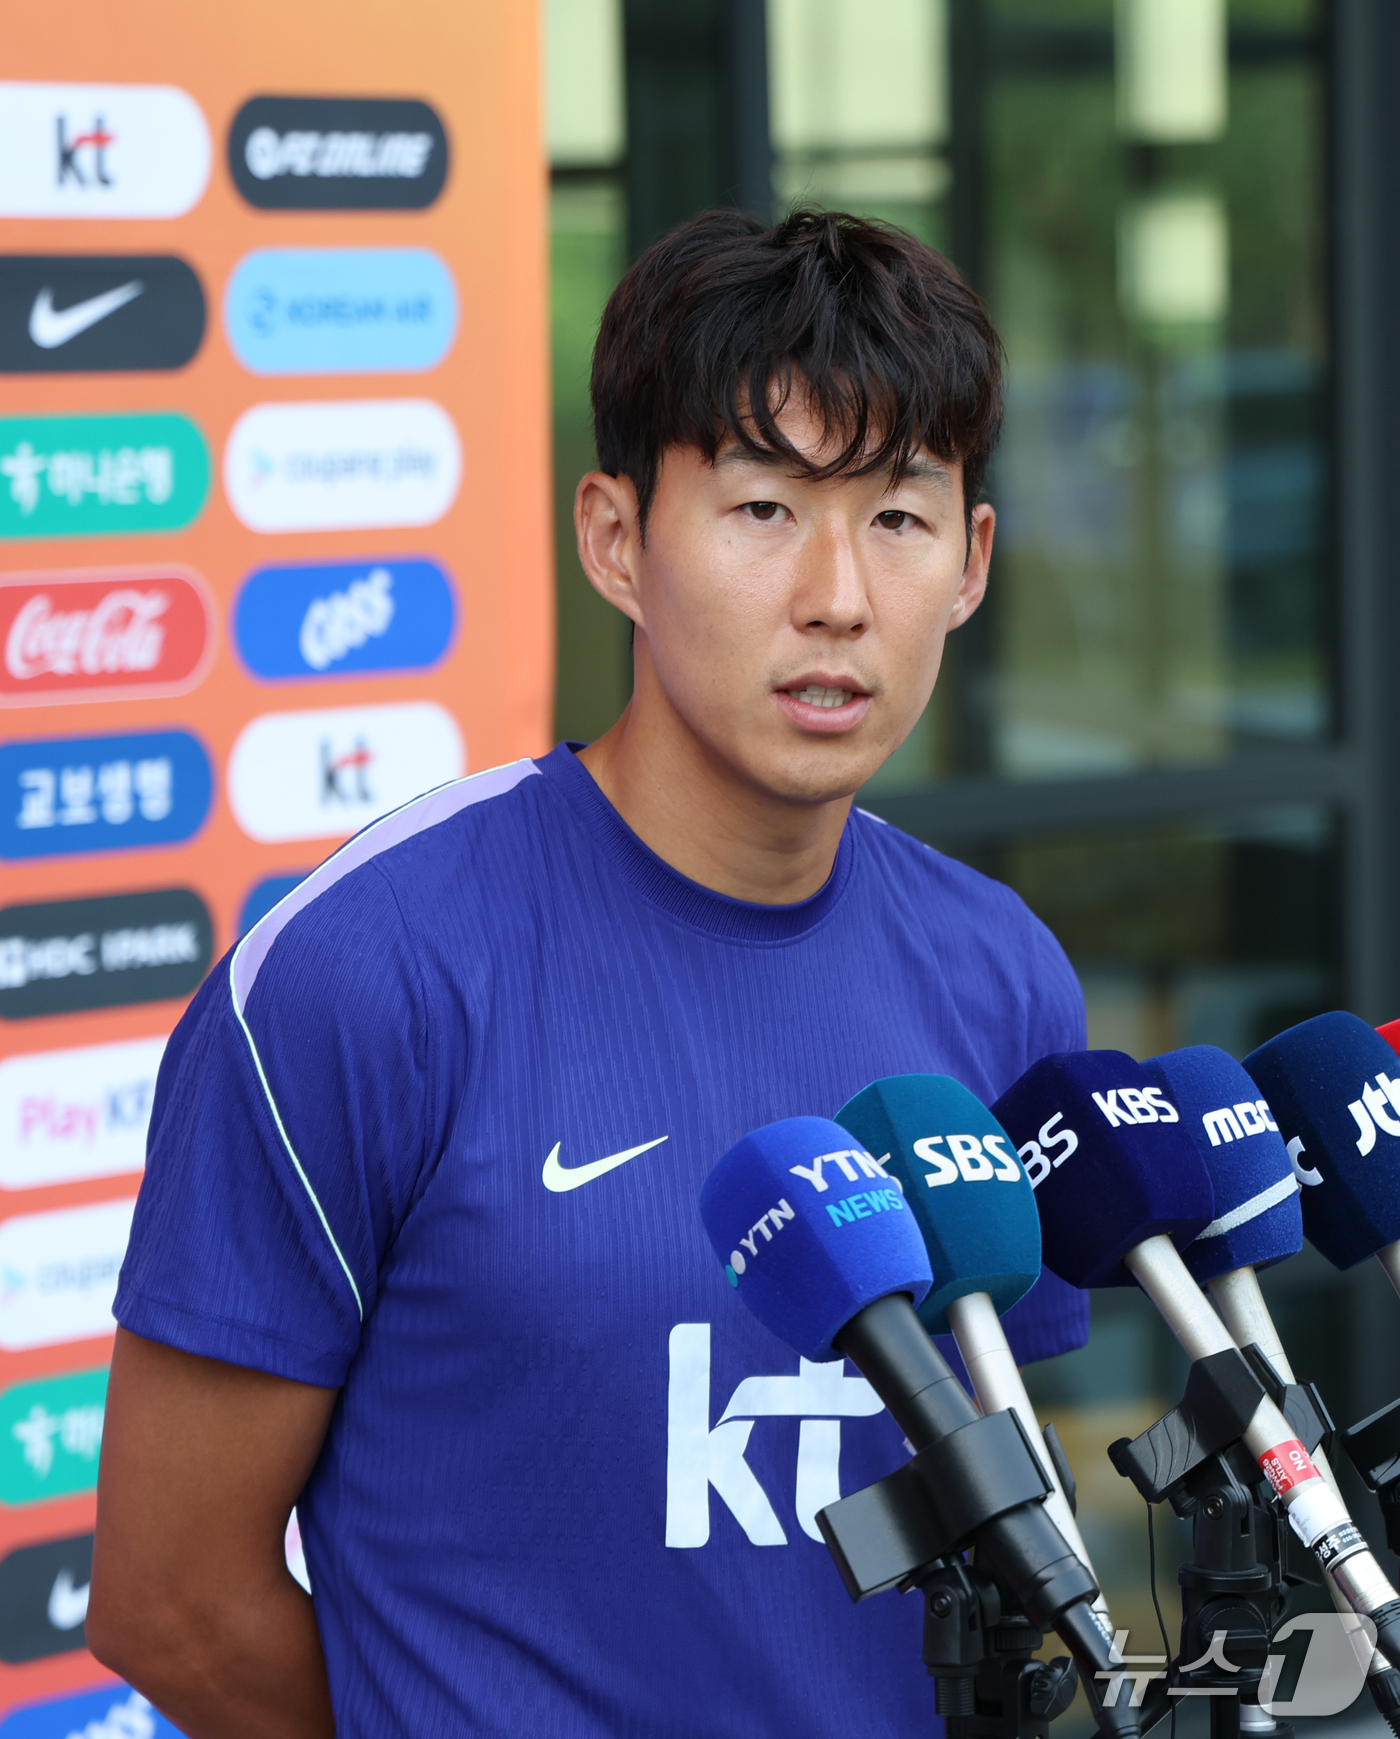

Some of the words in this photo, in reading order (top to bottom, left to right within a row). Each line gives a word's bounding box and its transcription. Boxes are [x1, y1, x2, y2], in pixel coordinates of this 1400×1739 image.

[56, 113, 117, 189] kt
[17, 756, 172, 830] 교보생명
[318, 732, 377, 808] kt
[1092, 1087, 1179, 1127] KBS
[789, 1149, 889, 1193] YTN
[913, 1134, 1021, 1188] SBS
[1018, 1111, 1078, 1190] BS
[739, 1198, 796, 1257] YTN
[825, 1188, 904, 1228] NEWS
[665, 1322, 886, 1549] kt
